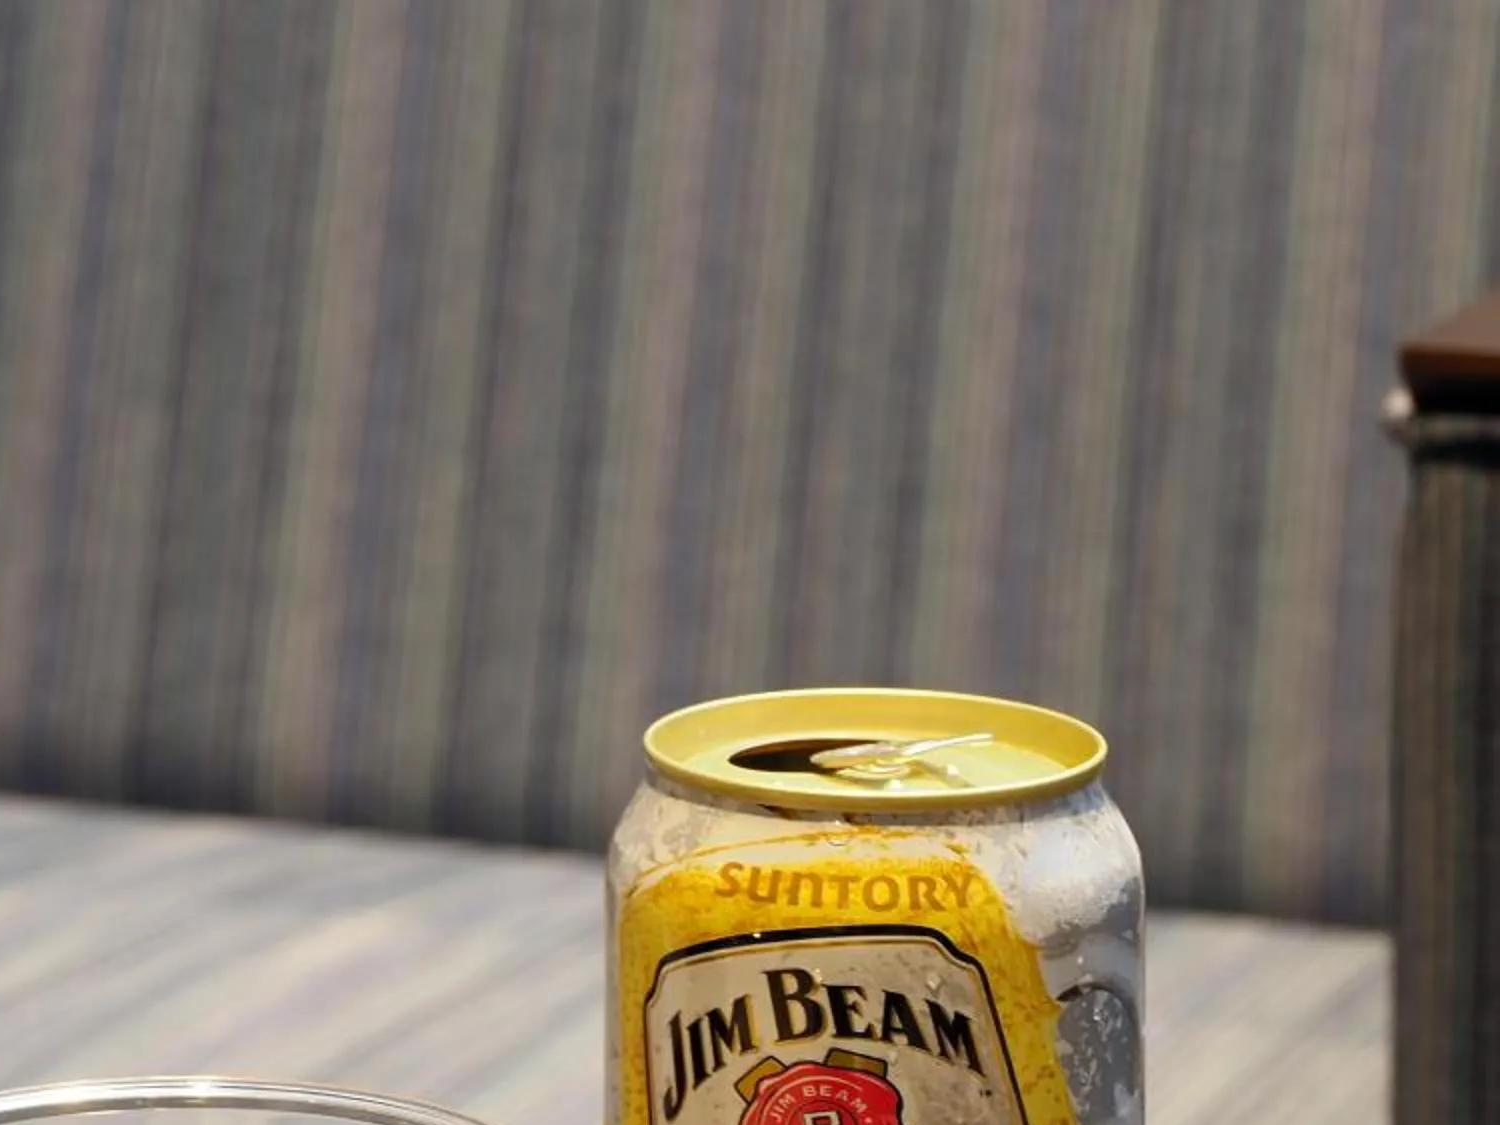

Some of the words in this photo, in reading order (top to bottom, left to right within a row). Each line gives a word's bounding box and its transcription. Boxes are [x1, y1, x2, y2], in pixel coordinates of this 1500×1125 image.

[713, 860, 975, 912] SUNTORY
[663, 994, 757, 1122] JIM
[761, 967, 987, 1078] BEAM
[770, 1092, 797, 1124] JIM
[802, 1084, 869, 1114] BEAM
